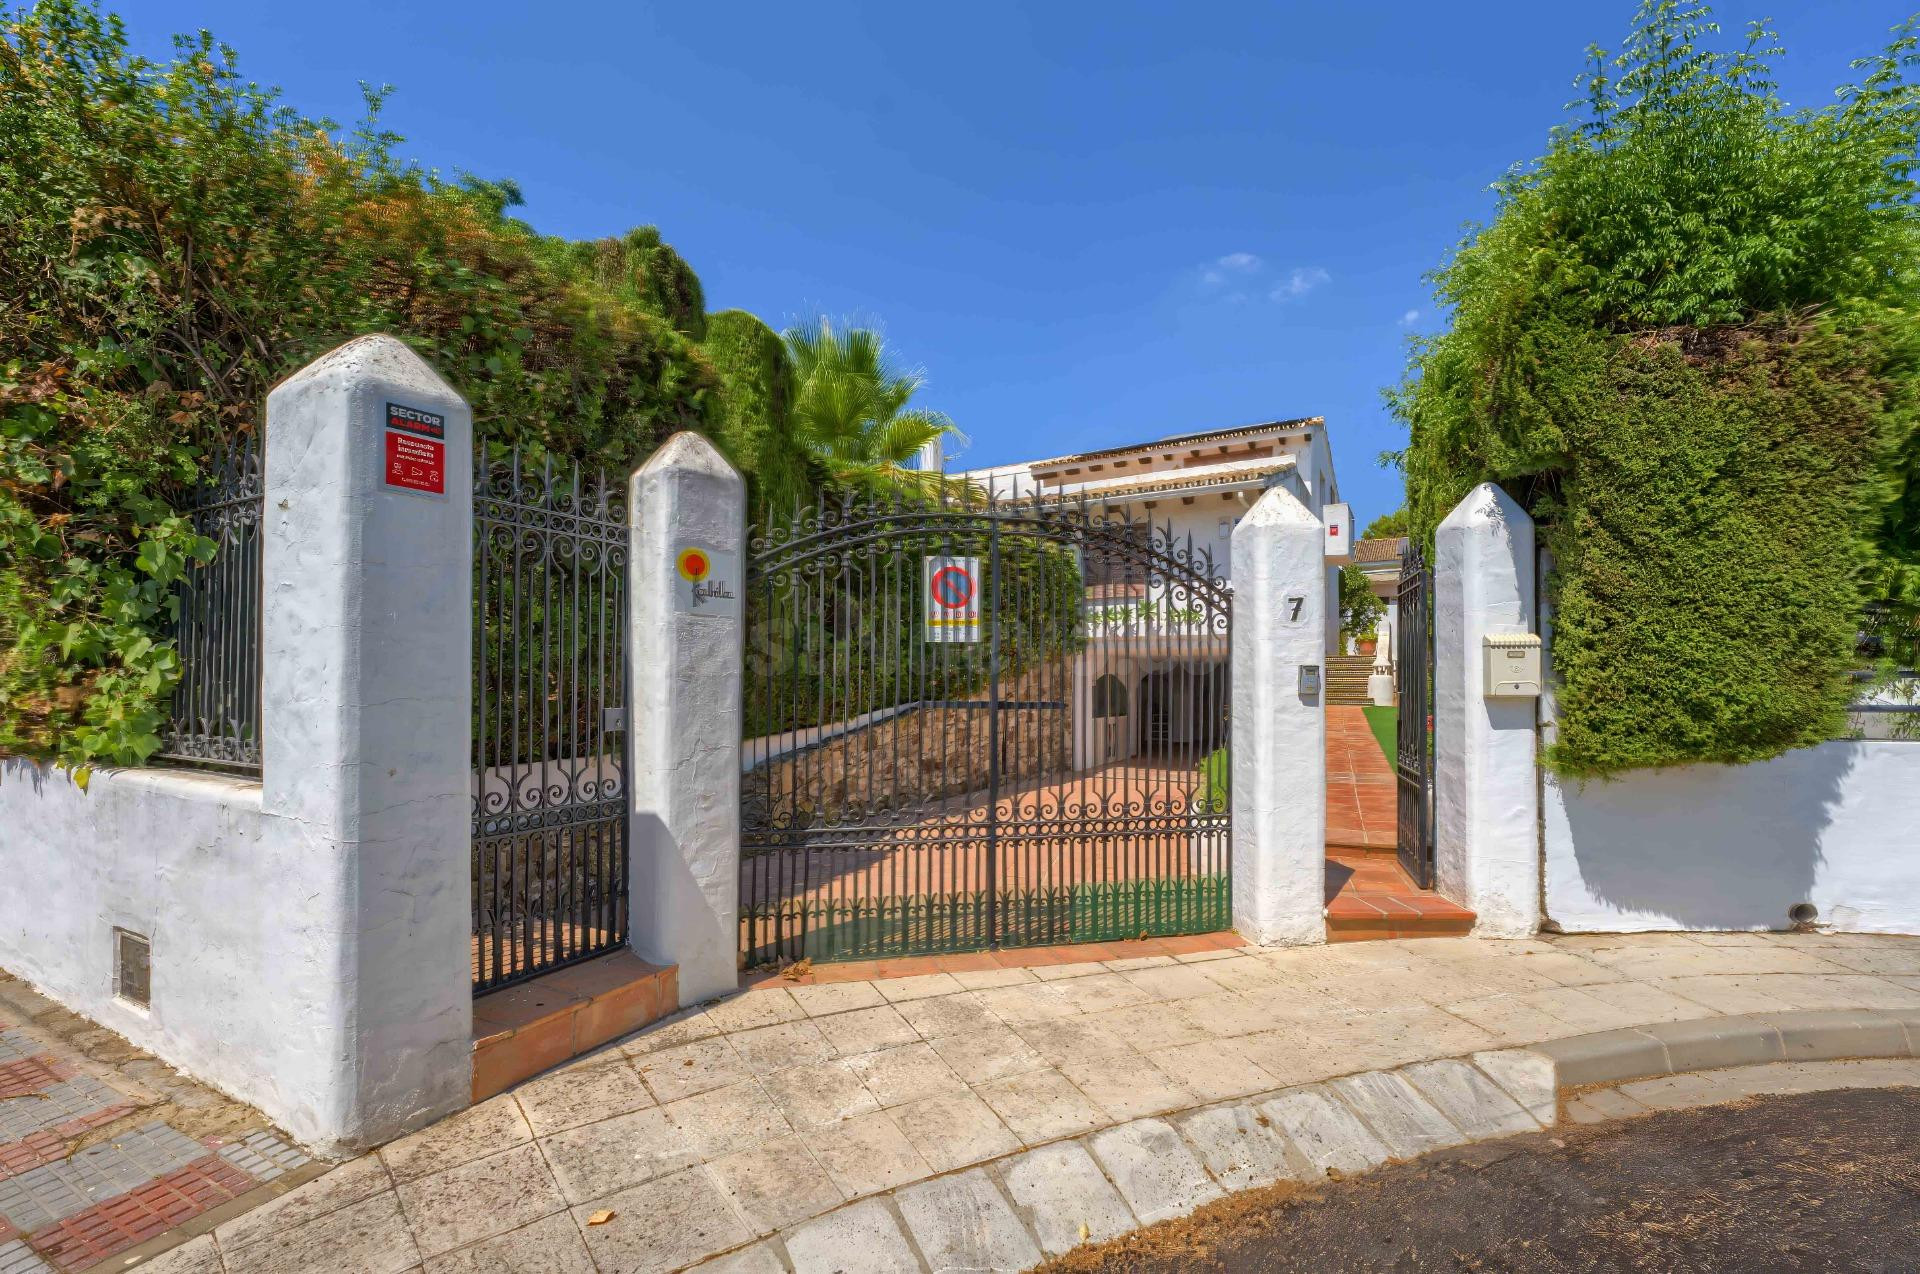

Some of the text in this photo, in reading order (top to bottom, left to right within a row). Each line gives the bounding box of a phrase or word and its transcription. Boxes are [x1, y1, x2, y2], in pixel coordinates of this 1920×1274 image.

[390, 406, 441, 427] SECTOR
[391, 417, 431, 432] ALARM
[1288, 597, 1304, 622] 7
